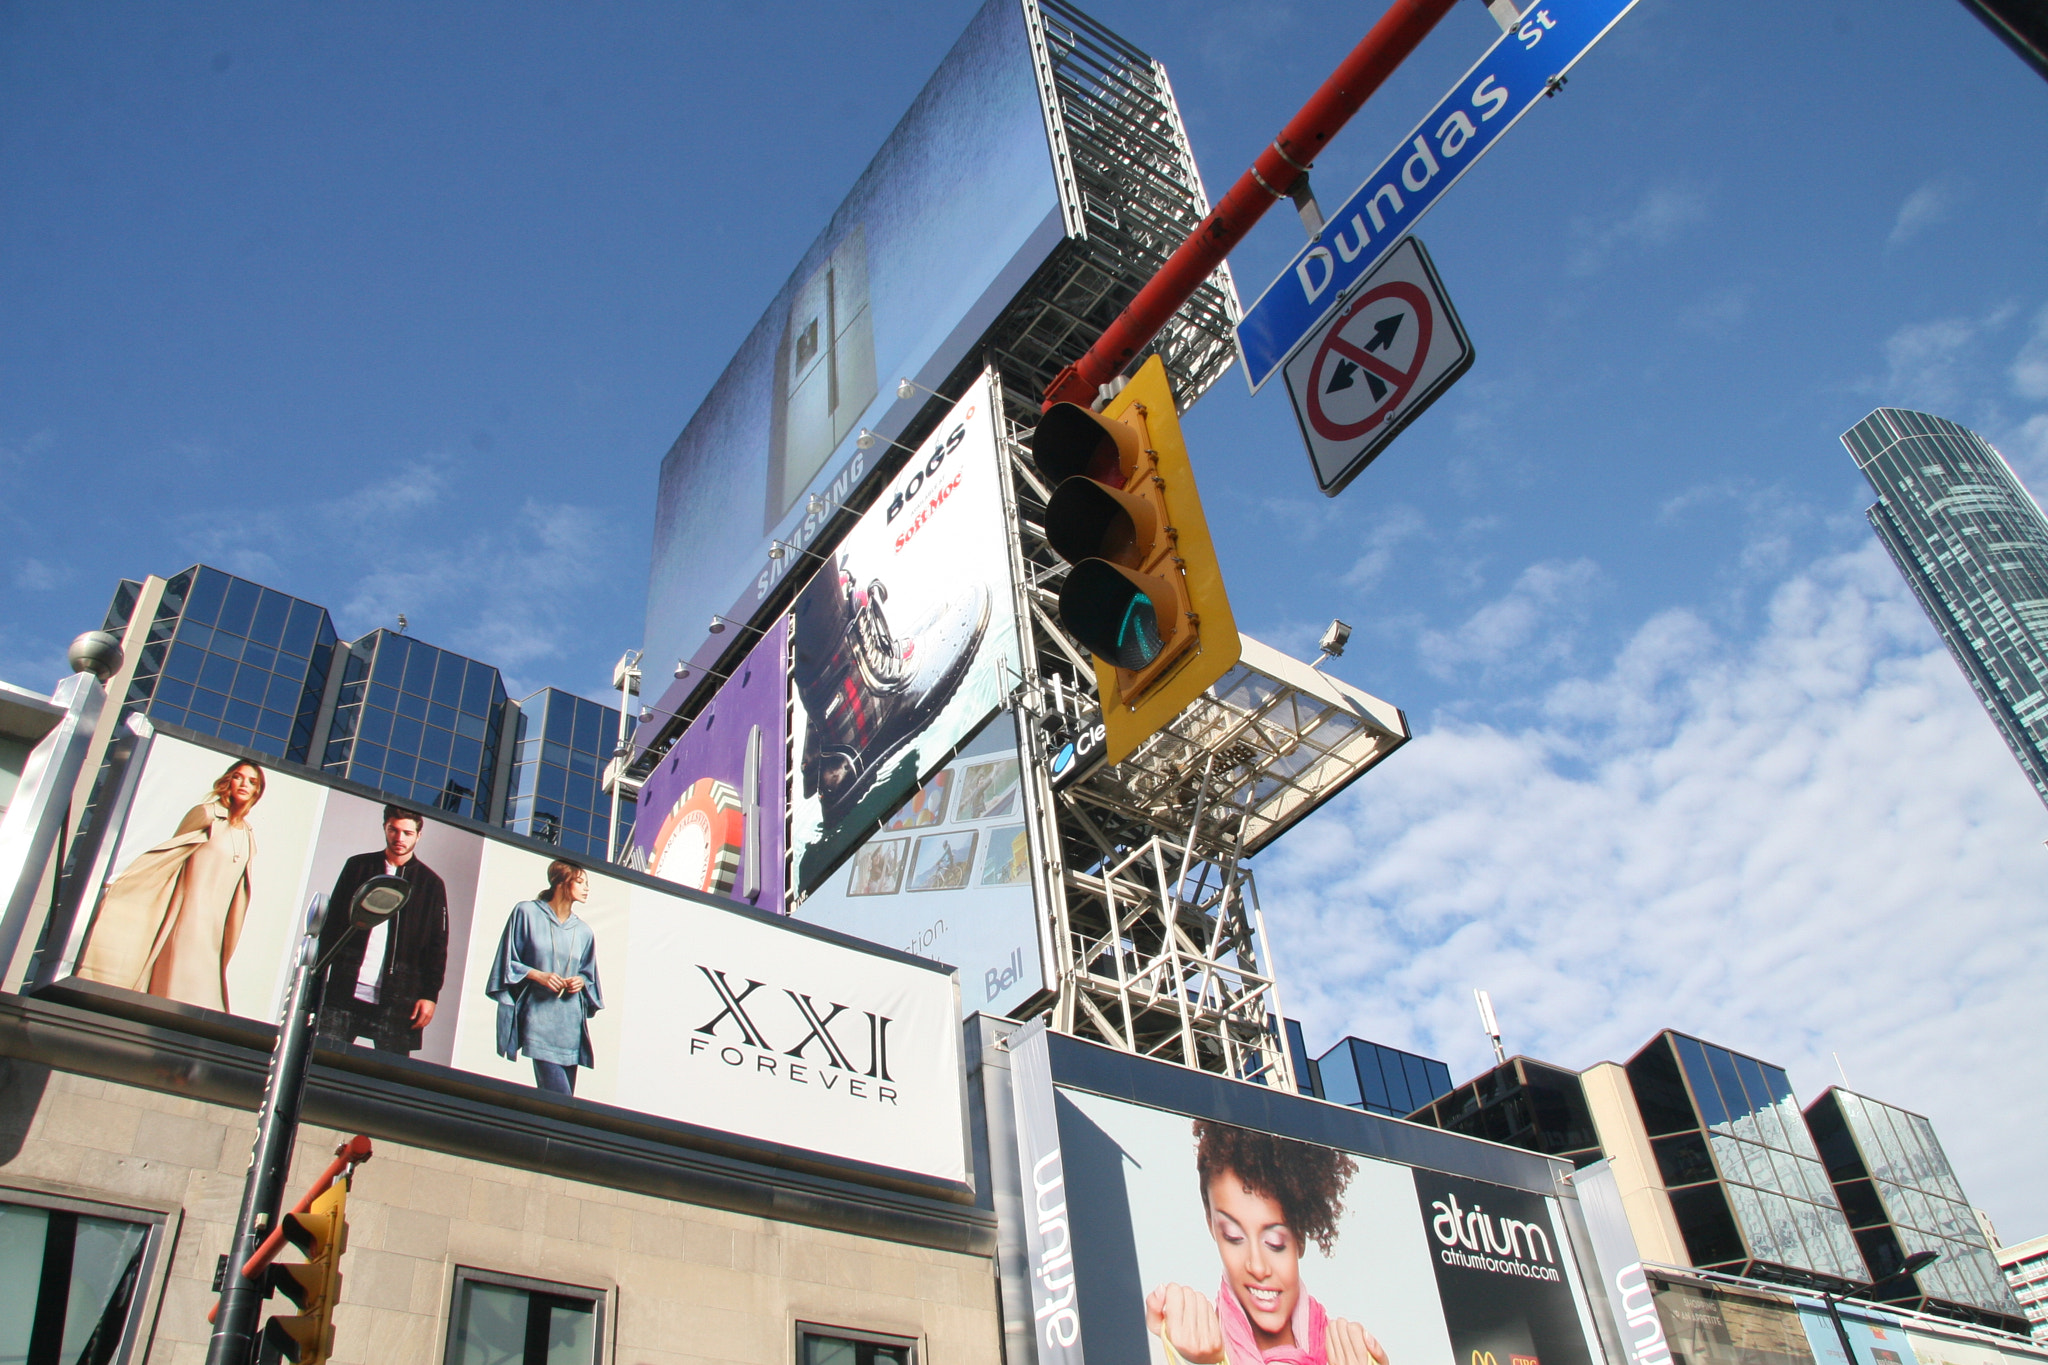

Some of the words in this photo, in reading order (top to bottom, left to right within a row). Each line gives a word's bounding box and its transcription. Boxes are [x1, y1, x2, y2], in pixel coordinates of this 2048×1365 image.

[1295, 74, 1509, 305] Dundas
[1517, 8, 1556, 50] St
[757, 452, 864, 600] SAMSUNG
[886, 422, 966, 526] BOGS
[693, 963, 896, 1083] XXI
[984, 947, 1024, 1003] Bell
[690, 1037, 898, 1106] FOREVER
[1033, 1147, 1079, 1349] atrium
[1432, 1193, 1554, 1263] atrium
[1440, 1249, 1561, 1283] atriumtoronto.com
